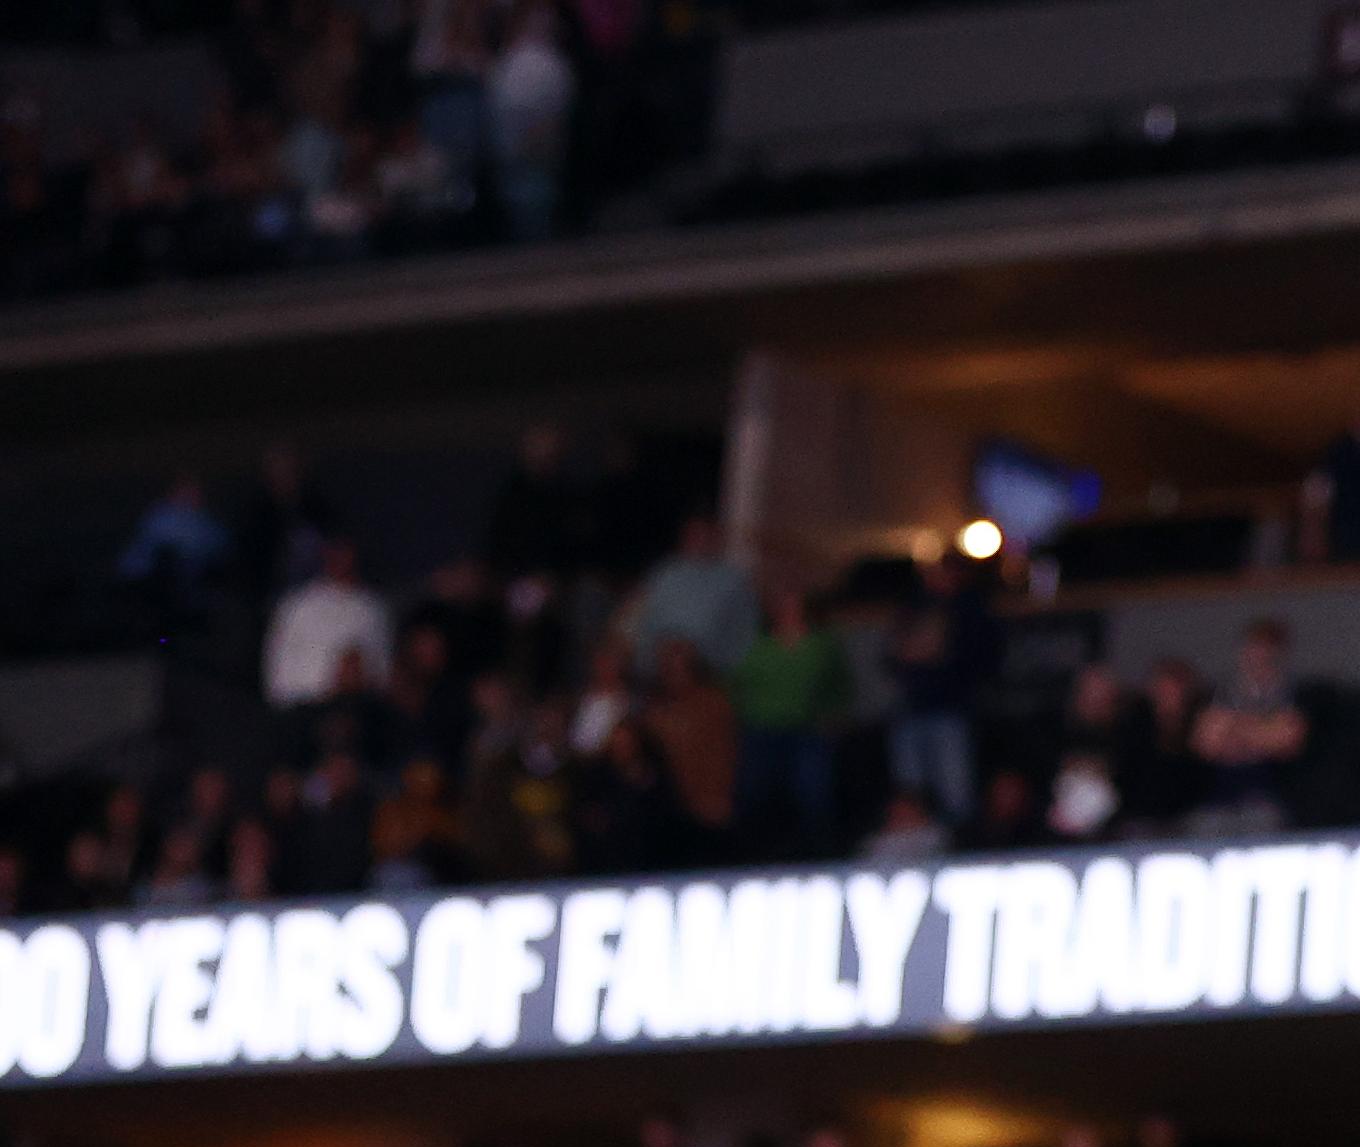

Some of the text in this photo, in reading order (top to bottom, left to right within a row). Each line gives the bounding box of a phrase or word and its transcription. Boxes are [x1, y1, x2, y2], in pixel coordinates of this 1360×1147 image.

[0, 926, 91, 1077] 0
[96, 904, 408, 1070] YEARS
[411, 894, 557, 1054] OF
[553, 870, 931, 1043] FAMILY
